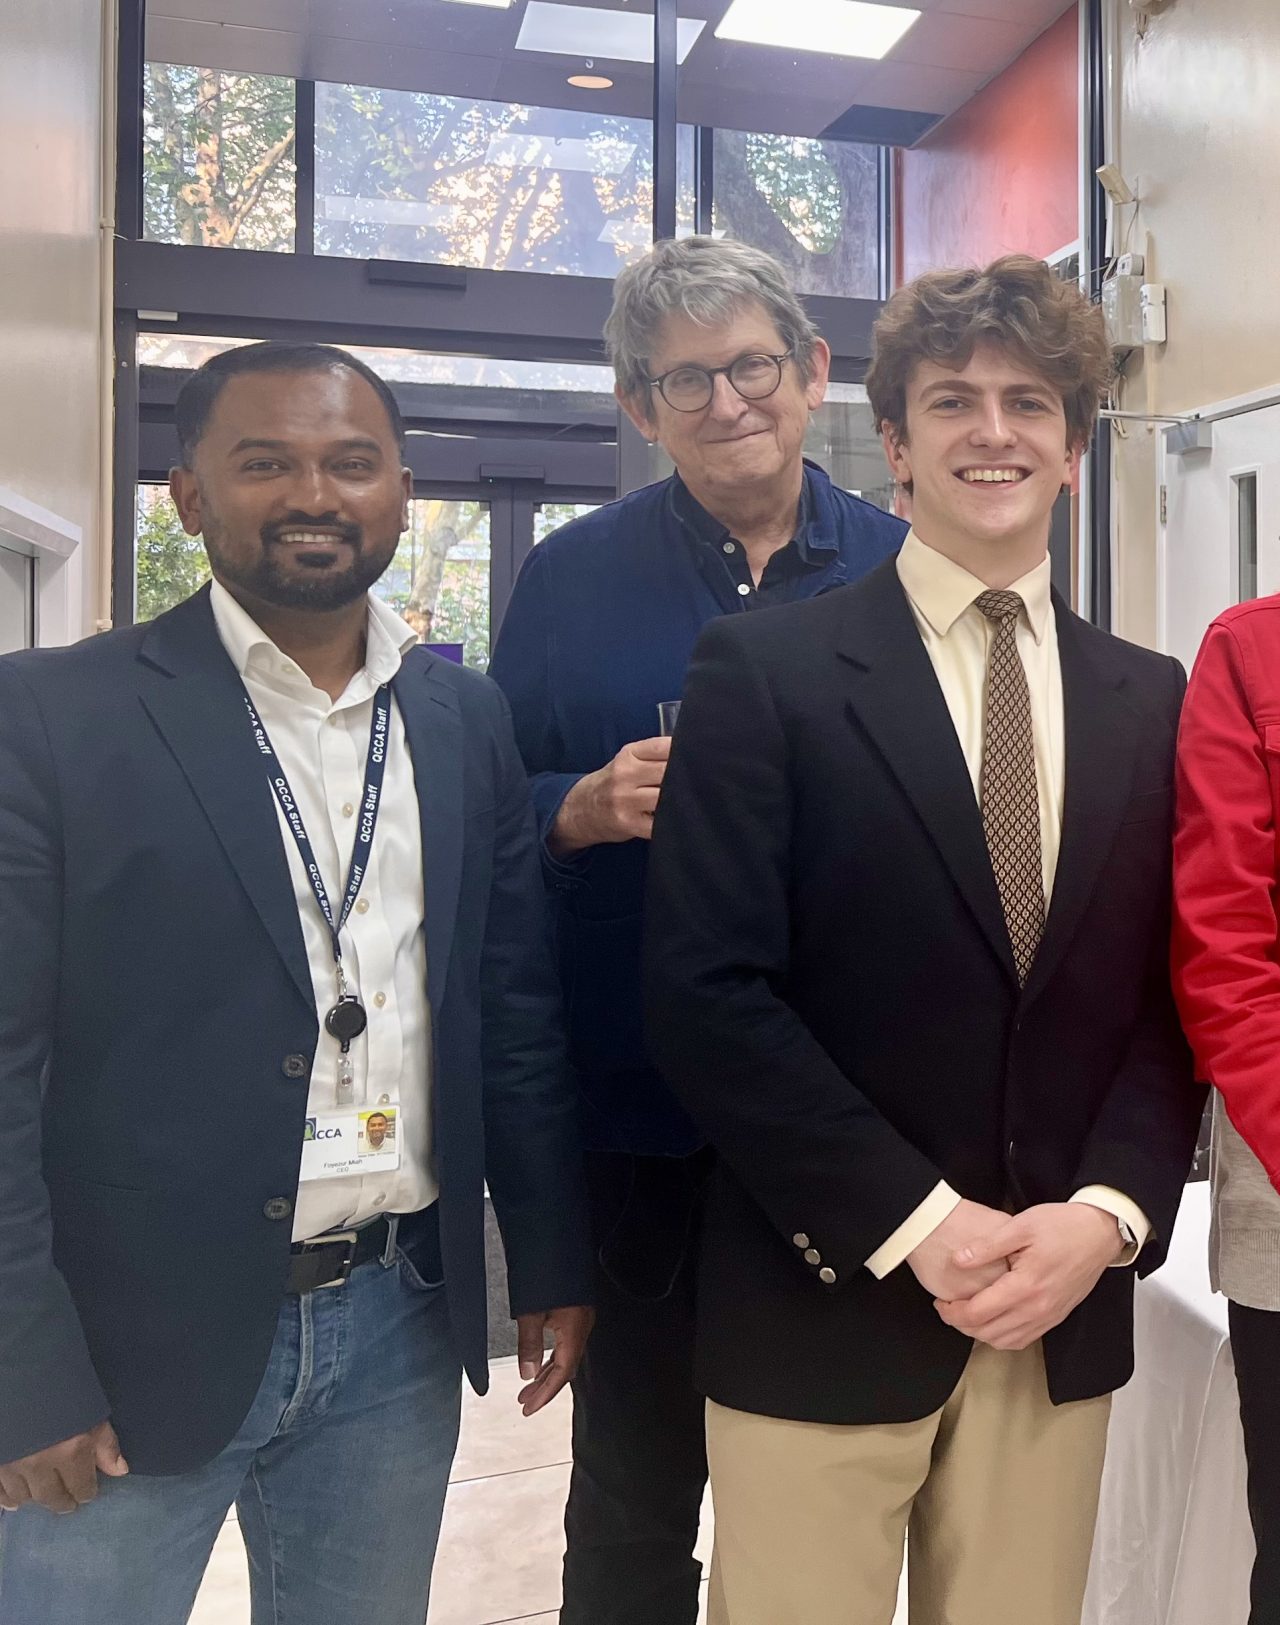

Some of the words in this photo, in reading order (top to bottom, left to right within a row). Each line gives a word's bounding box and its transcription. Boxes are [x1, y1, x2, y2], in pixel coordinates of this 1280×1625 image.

[375, 707, 387, 732] Staff
[254, 728, 272, 754] Staff
[372, 732, 385, 763] QCCA
[274, 777, 294, 812] QCCA
[289, 811, 307, 840] Staff
[366, 784, 379, 812] Staff
[360, 811, 374, 844] QCCA
[308, 863, 325, 898] QCCA
[349, 864, 363, 893] Staff
